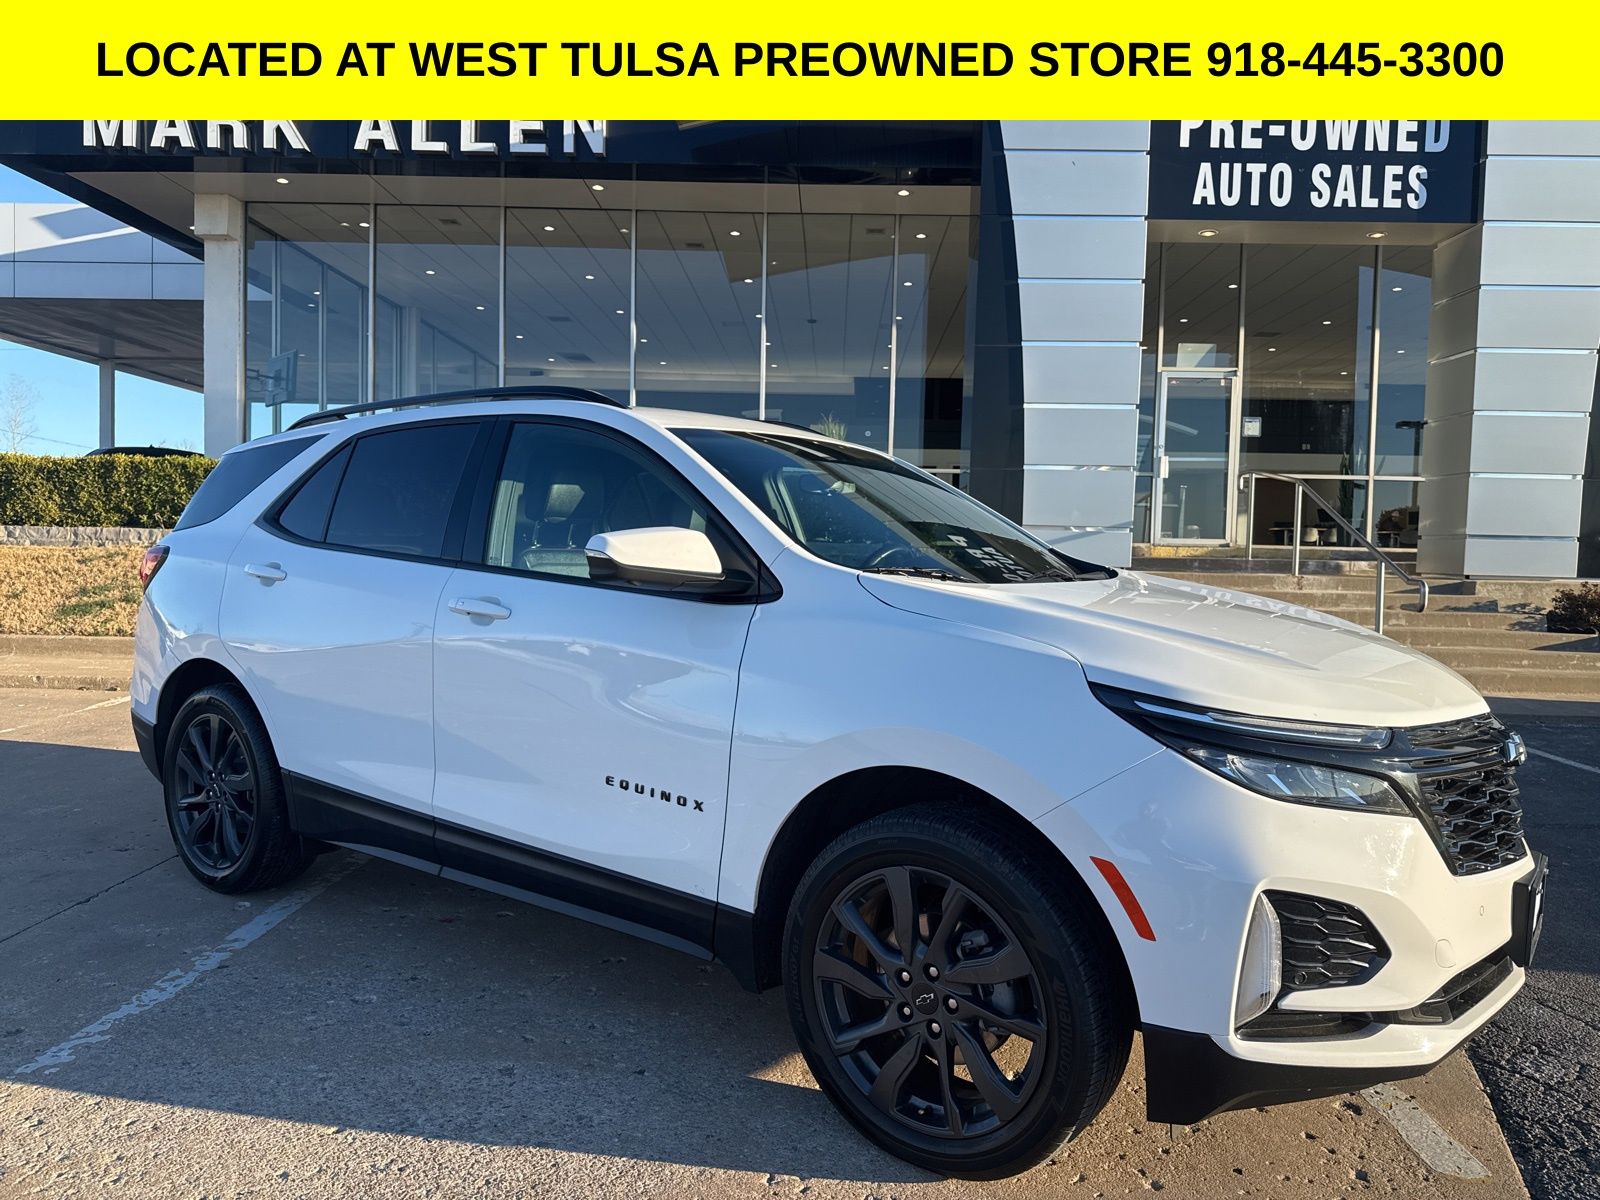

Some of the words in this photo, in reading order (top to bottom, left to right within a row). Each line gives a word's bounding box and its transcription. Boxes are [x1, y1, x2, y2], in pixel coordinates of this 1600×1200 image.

[82, 120, 311, 152] MARK
[353, 120, 606, 157] ALLEN
[1179, 120, 1450, 152] PRE-OWNED
[1192, 162, 1292, 207] AUTO
[1310, 163, 1428, 209] SALES
[605, 775, 704, 812] EQUINOX
